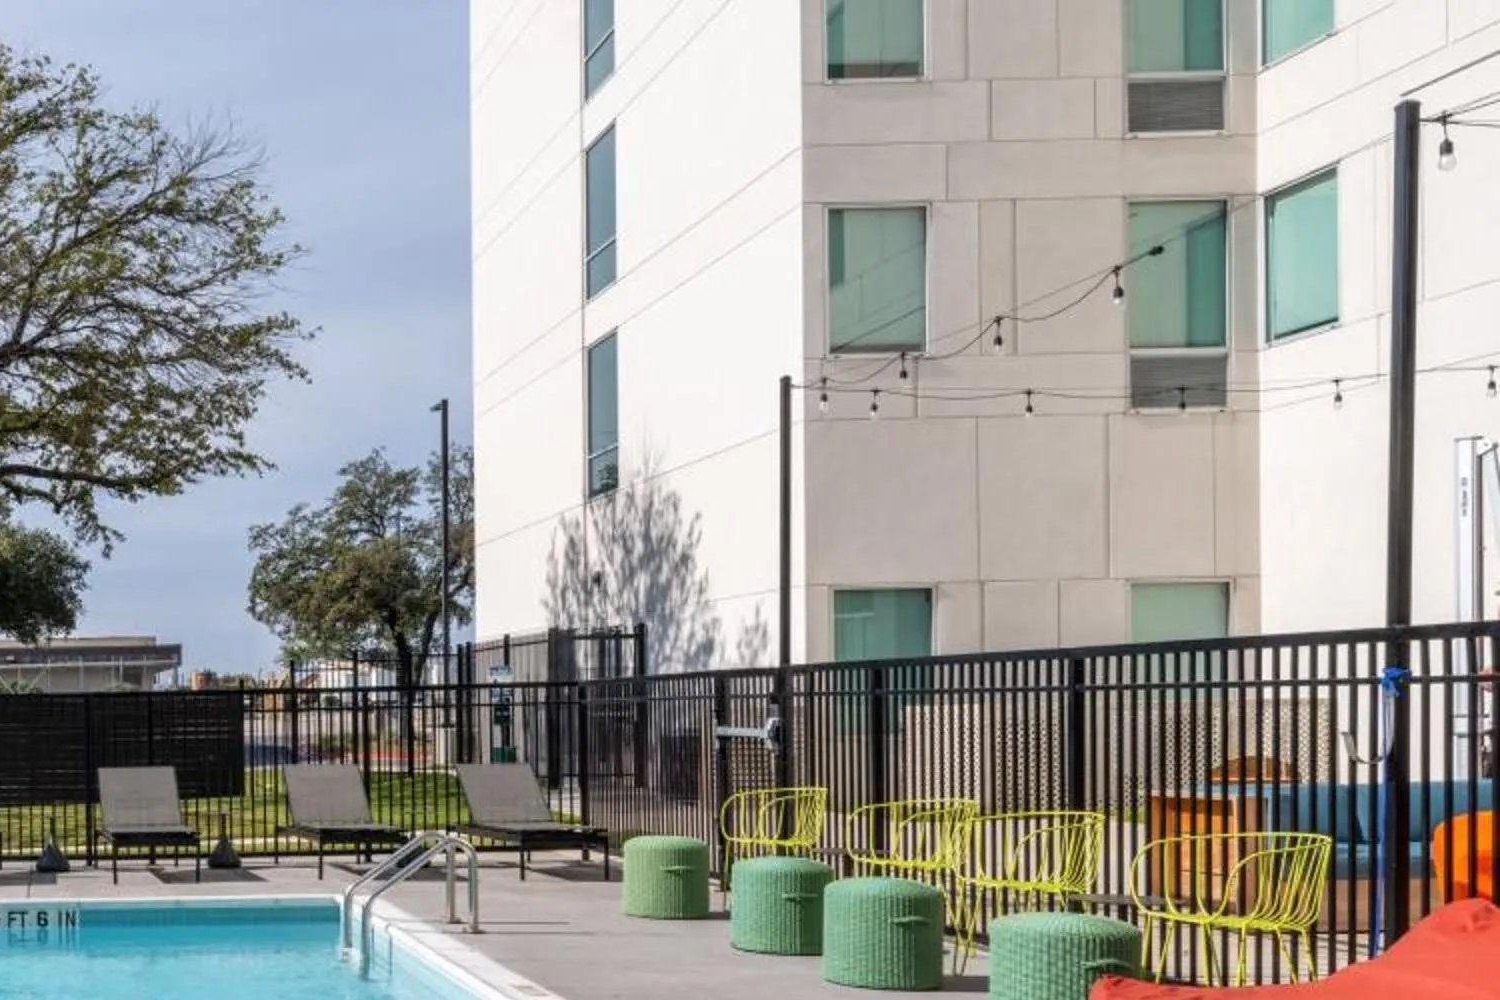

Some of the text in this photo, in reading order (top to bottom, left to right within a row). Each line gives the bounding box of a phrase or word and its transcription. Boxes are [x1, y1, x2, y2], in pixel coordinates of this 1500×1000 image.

[7, 911, 28, 928] FT
[36, 911, 49, 927] 6
[58, 910, 76, 928] IN
